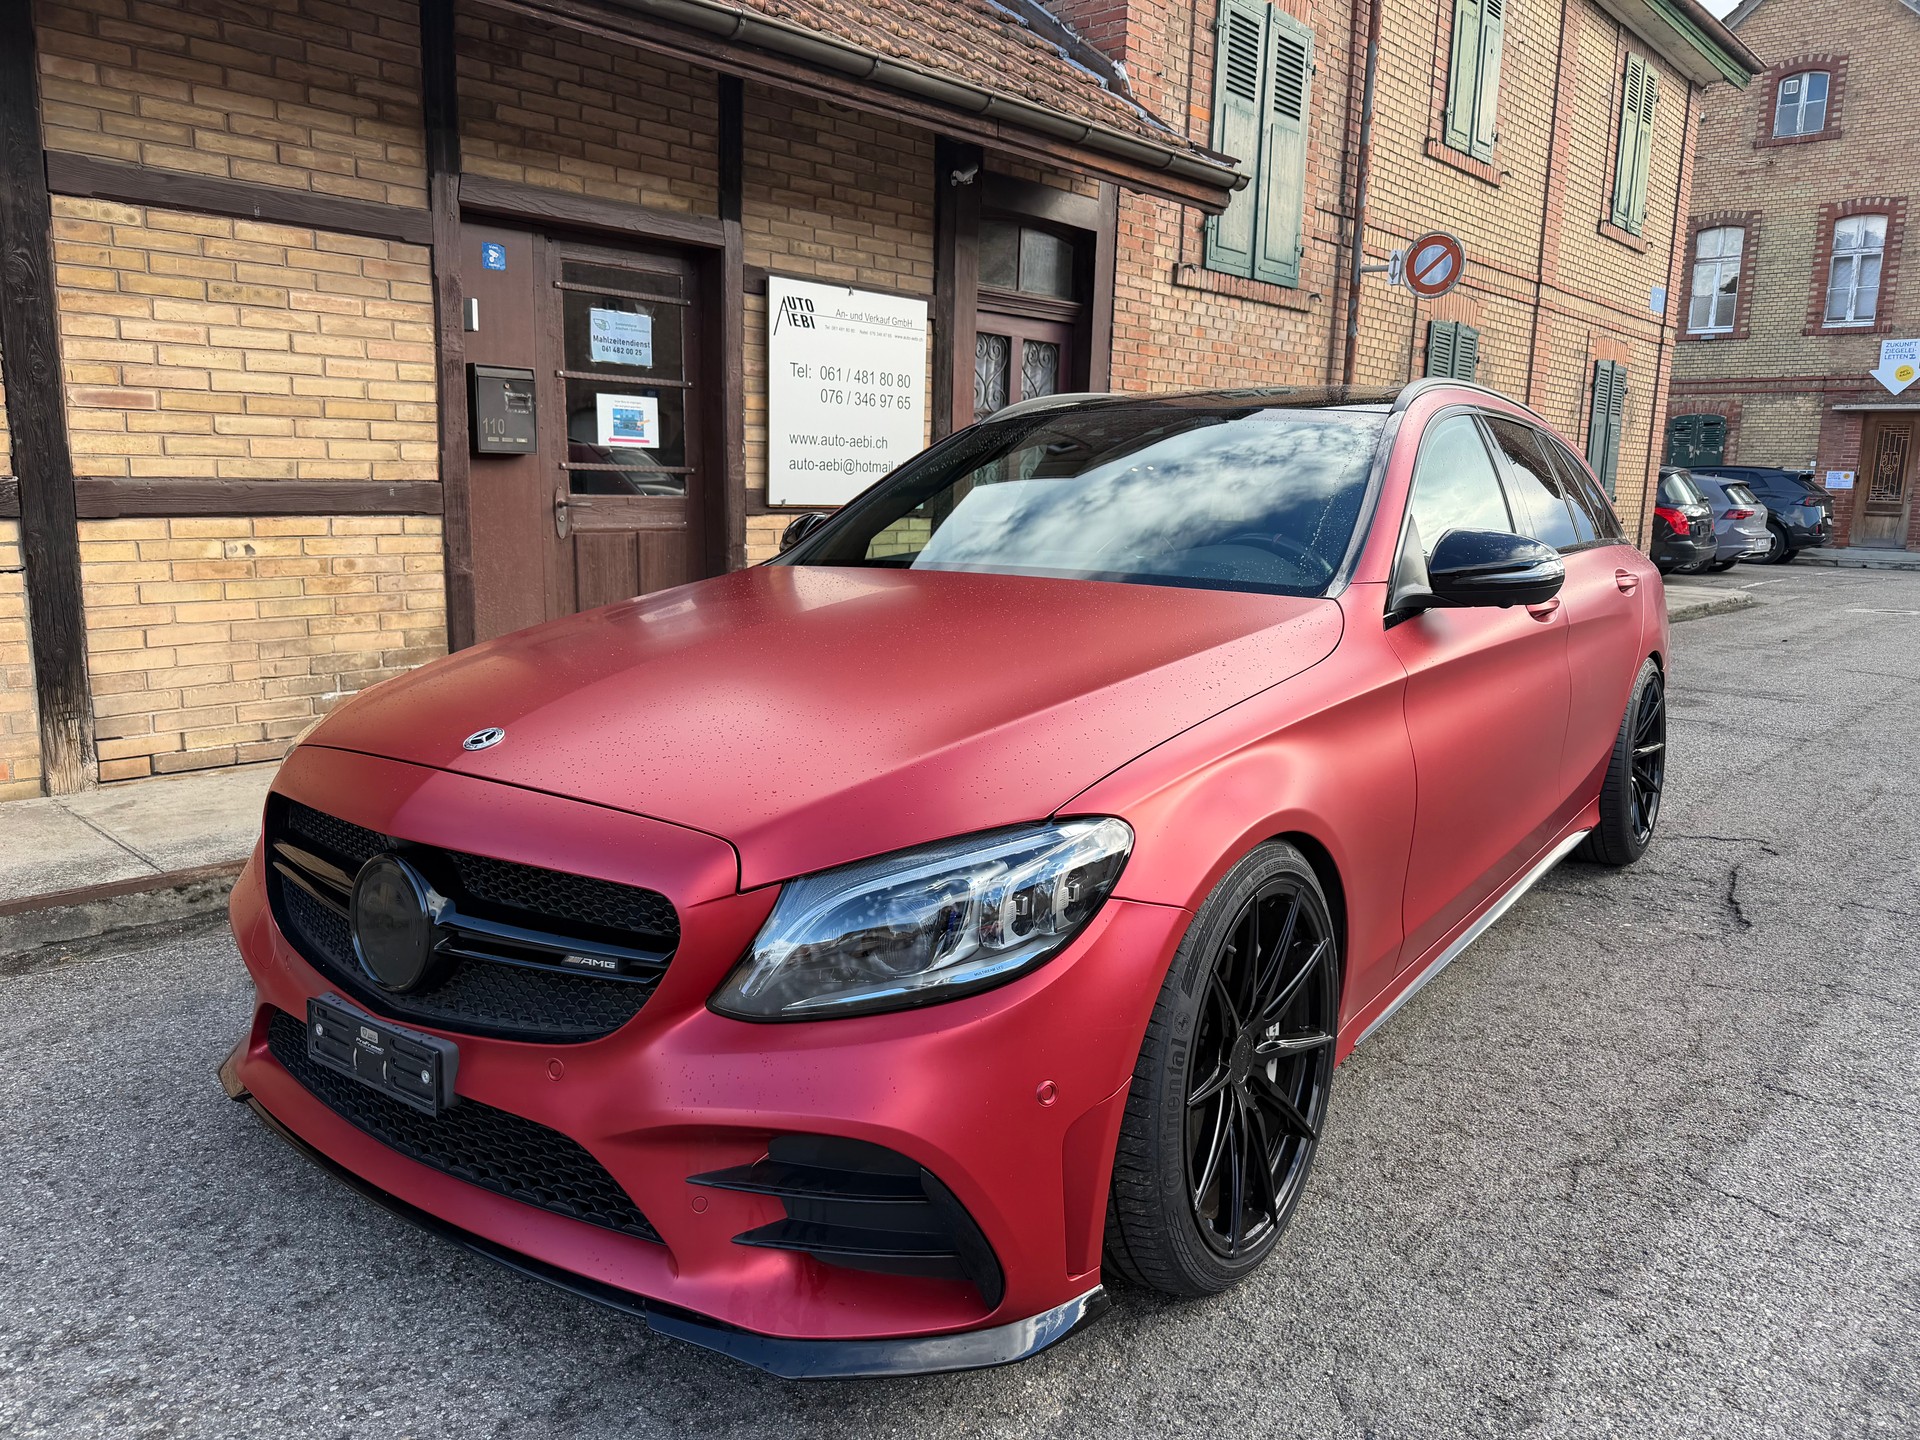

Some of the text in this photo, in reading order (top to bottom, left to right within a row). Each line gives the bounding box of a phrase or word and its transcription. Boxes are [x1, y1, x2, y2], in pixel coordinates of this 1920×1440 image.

[836, 308, 913, 328] An- und Verkauf GmbH
[593, 335, 651, 348] Mahlzeitendienst
[790, 362, 812, 379] Tel:
[820, 365, 841, 381] 061
[854, 369, 875, 385] 481
[879, 372, 894, 387] 80
[897, 374, 911, 389] 80
[820, 388, 843, 404] 076
[854, 392, 876, 407] 346
[879, 394, 893, 408] 97
[897, 395, 911, 410] 65
[483, 417, 505, 434] 110
[789, 434, 888, 449] www.auto-aebi.ch
[580, 958, 616, 969] AMG
[1163, 1038, 1188, 1196] Continental
